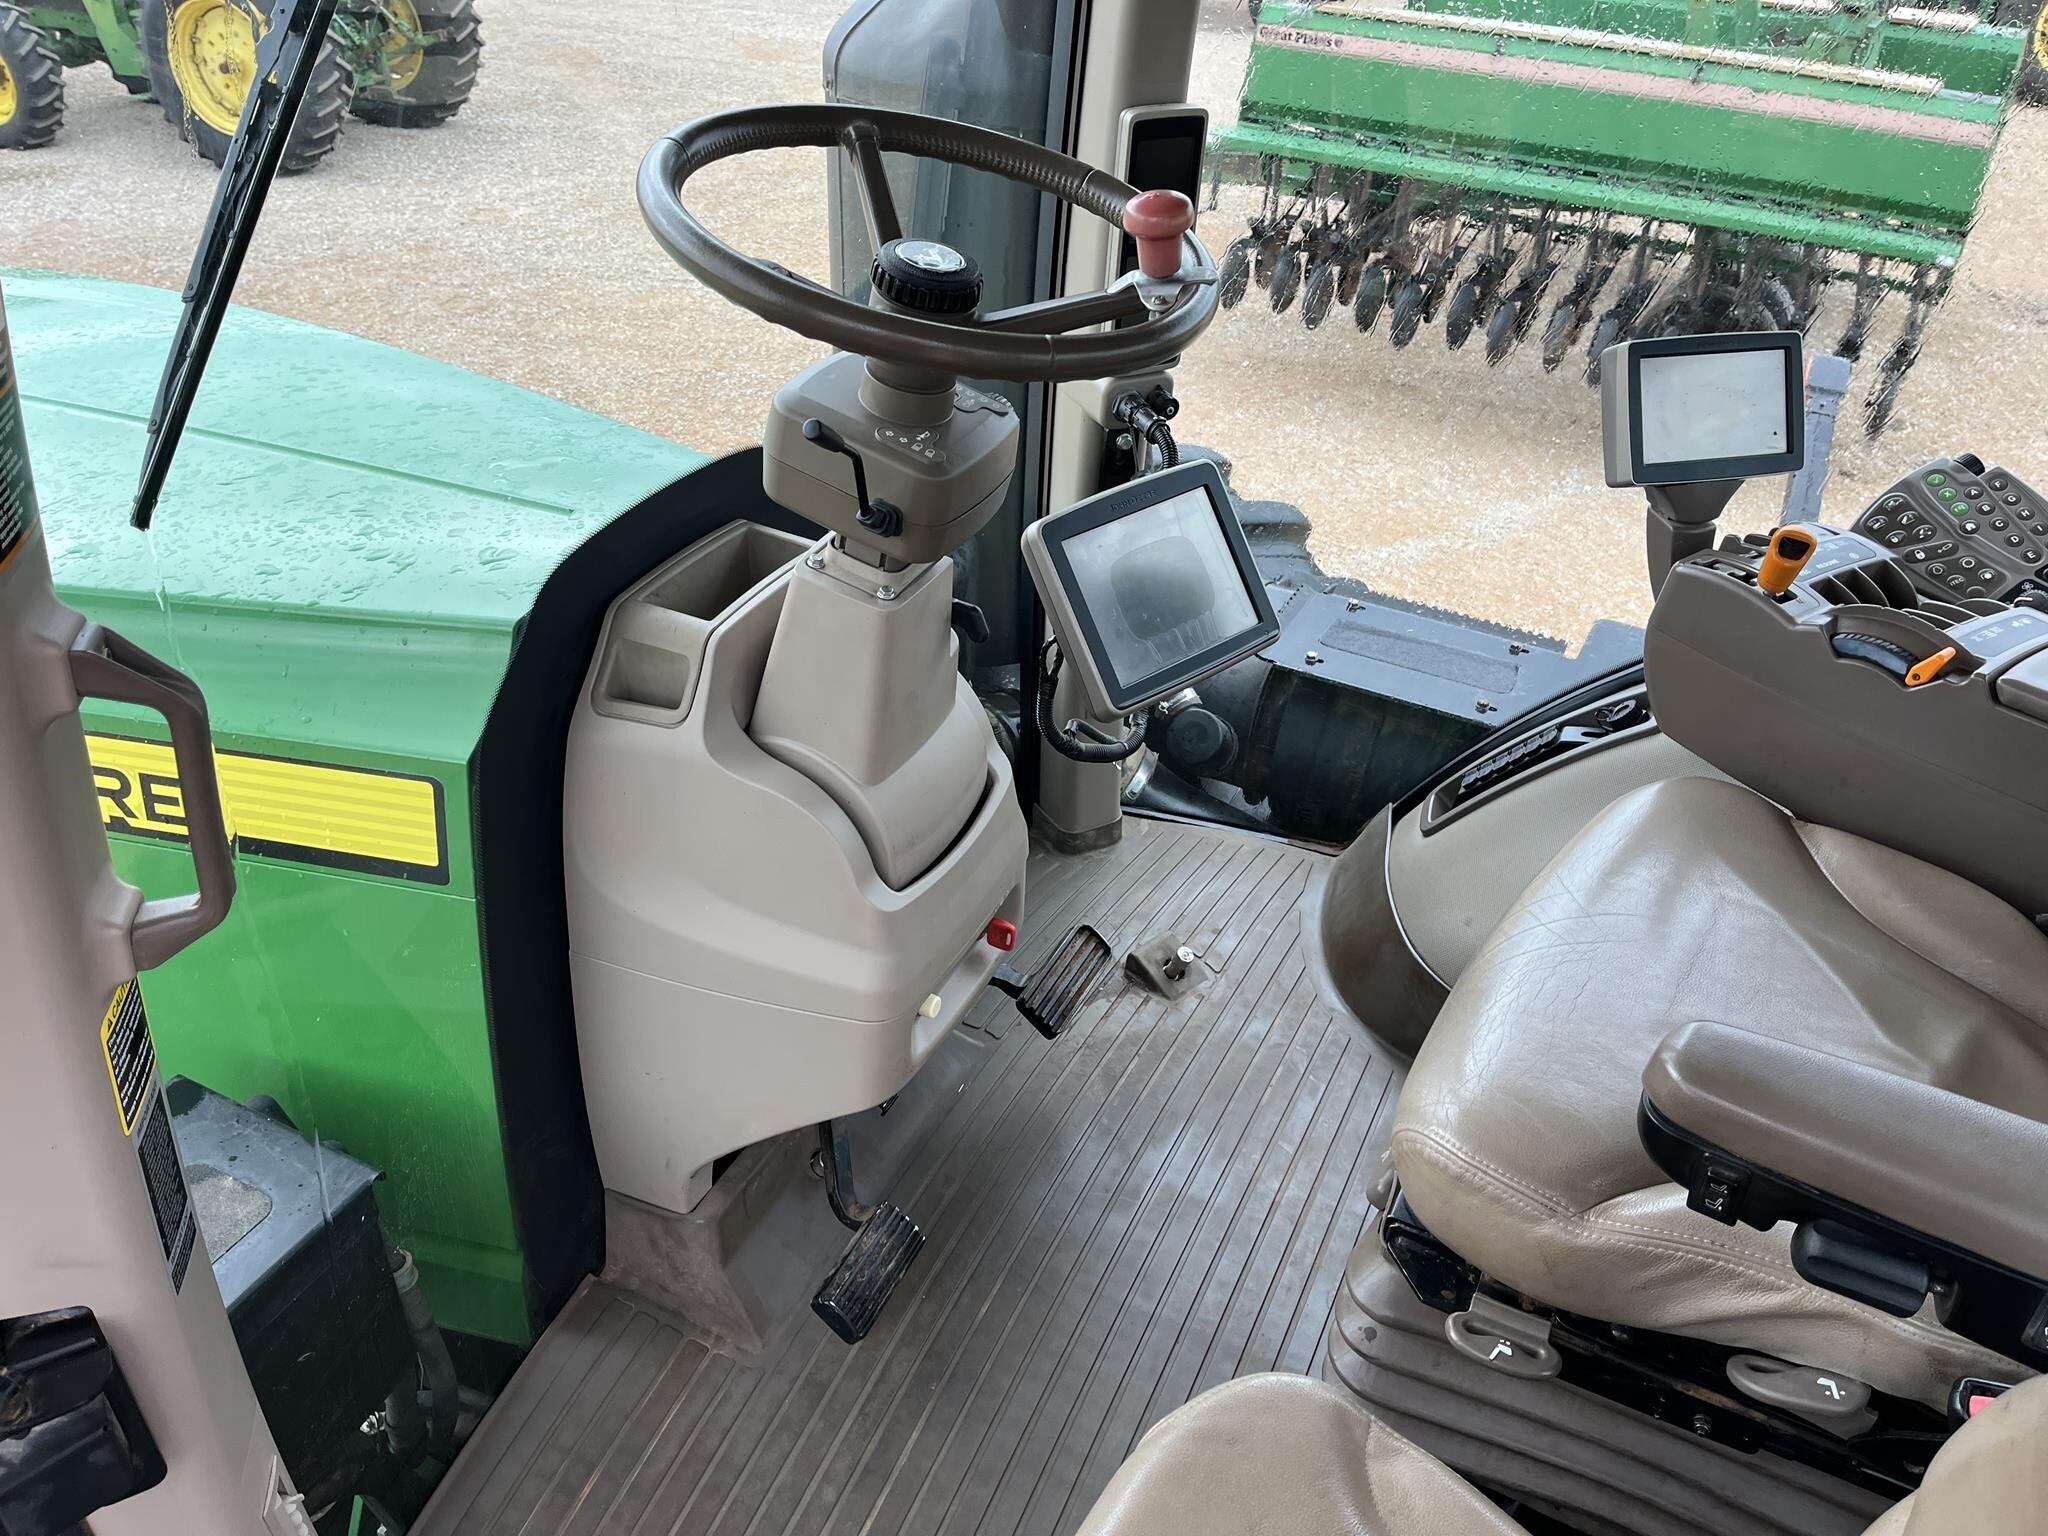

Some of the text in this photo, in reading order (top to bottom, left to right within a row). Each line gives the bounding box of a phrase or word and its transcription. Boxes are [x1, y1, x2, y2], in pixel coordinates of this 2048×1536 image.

[1970, 489, 1979, 497] A
[2007, 495, 2017, 503] G
[1981, 504, 1991, 512] B
[2020, 509, 2030, 518] H
[2010, 535, 2020, 544] D
[2026, 550, 2037, 559] E
